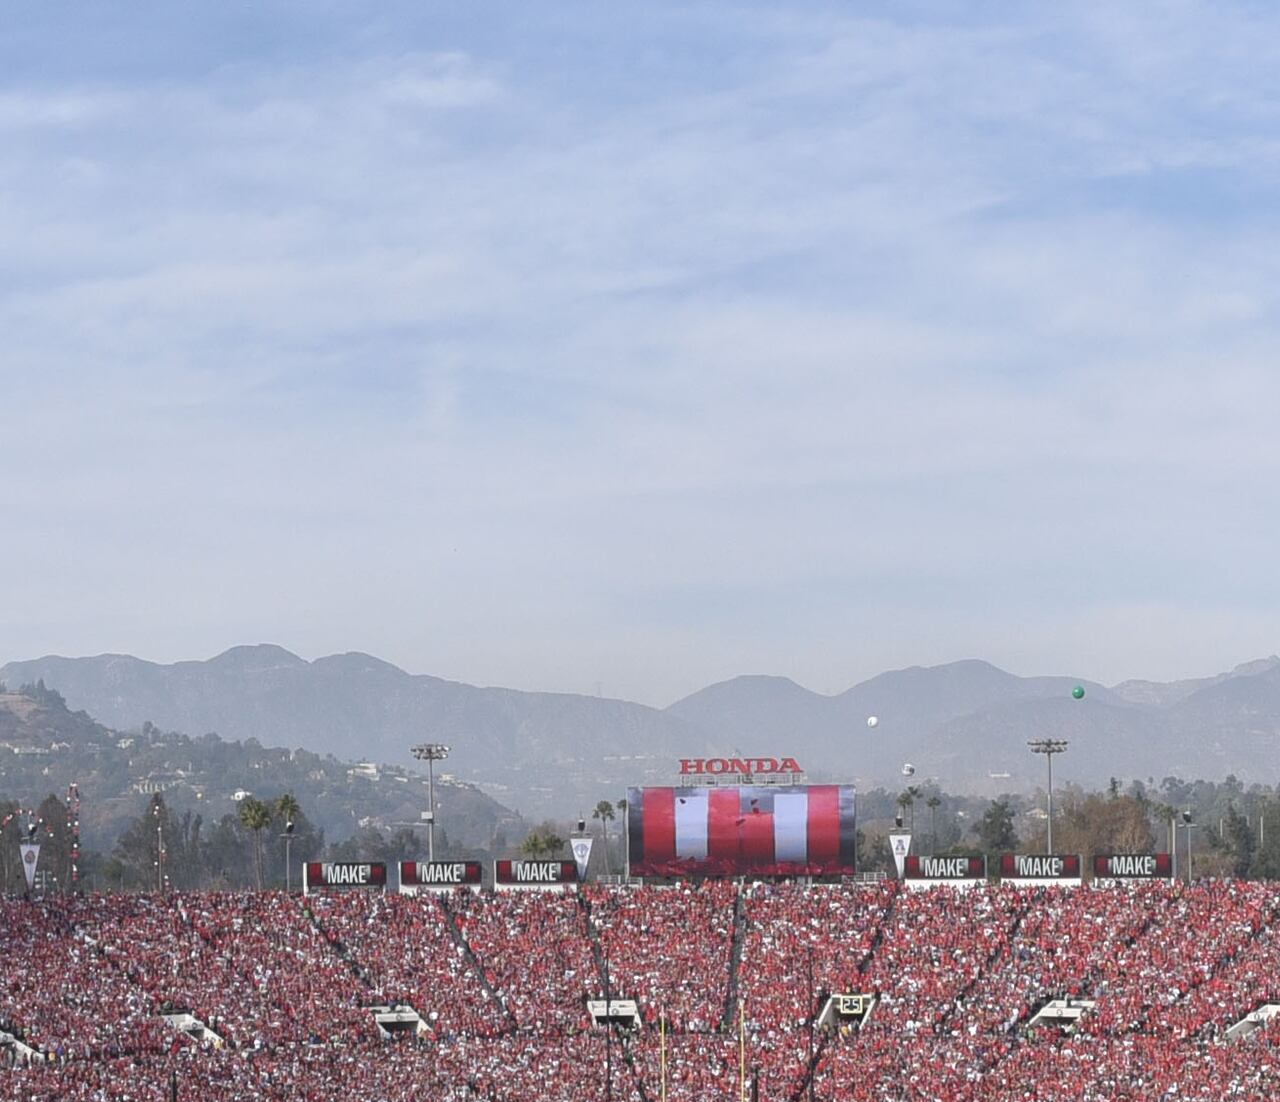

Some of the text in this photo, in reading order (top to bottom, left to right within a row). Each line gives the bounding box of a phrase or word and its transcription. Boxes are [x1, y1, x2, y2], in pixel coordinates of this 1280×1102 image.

[679, 758, 803, 775] HONDA
[327, 864, 366, 883] MAKE
[422, 863, 461, 882] MAKE
[517, 863, 556, 881] MAKE
[924, 857, 964, 876] MAKE
[1019, 857, 1059, 876] MAKE
[1112, 856, 1152, 875] MAKE
[842, 999, 861, 1012] 25
